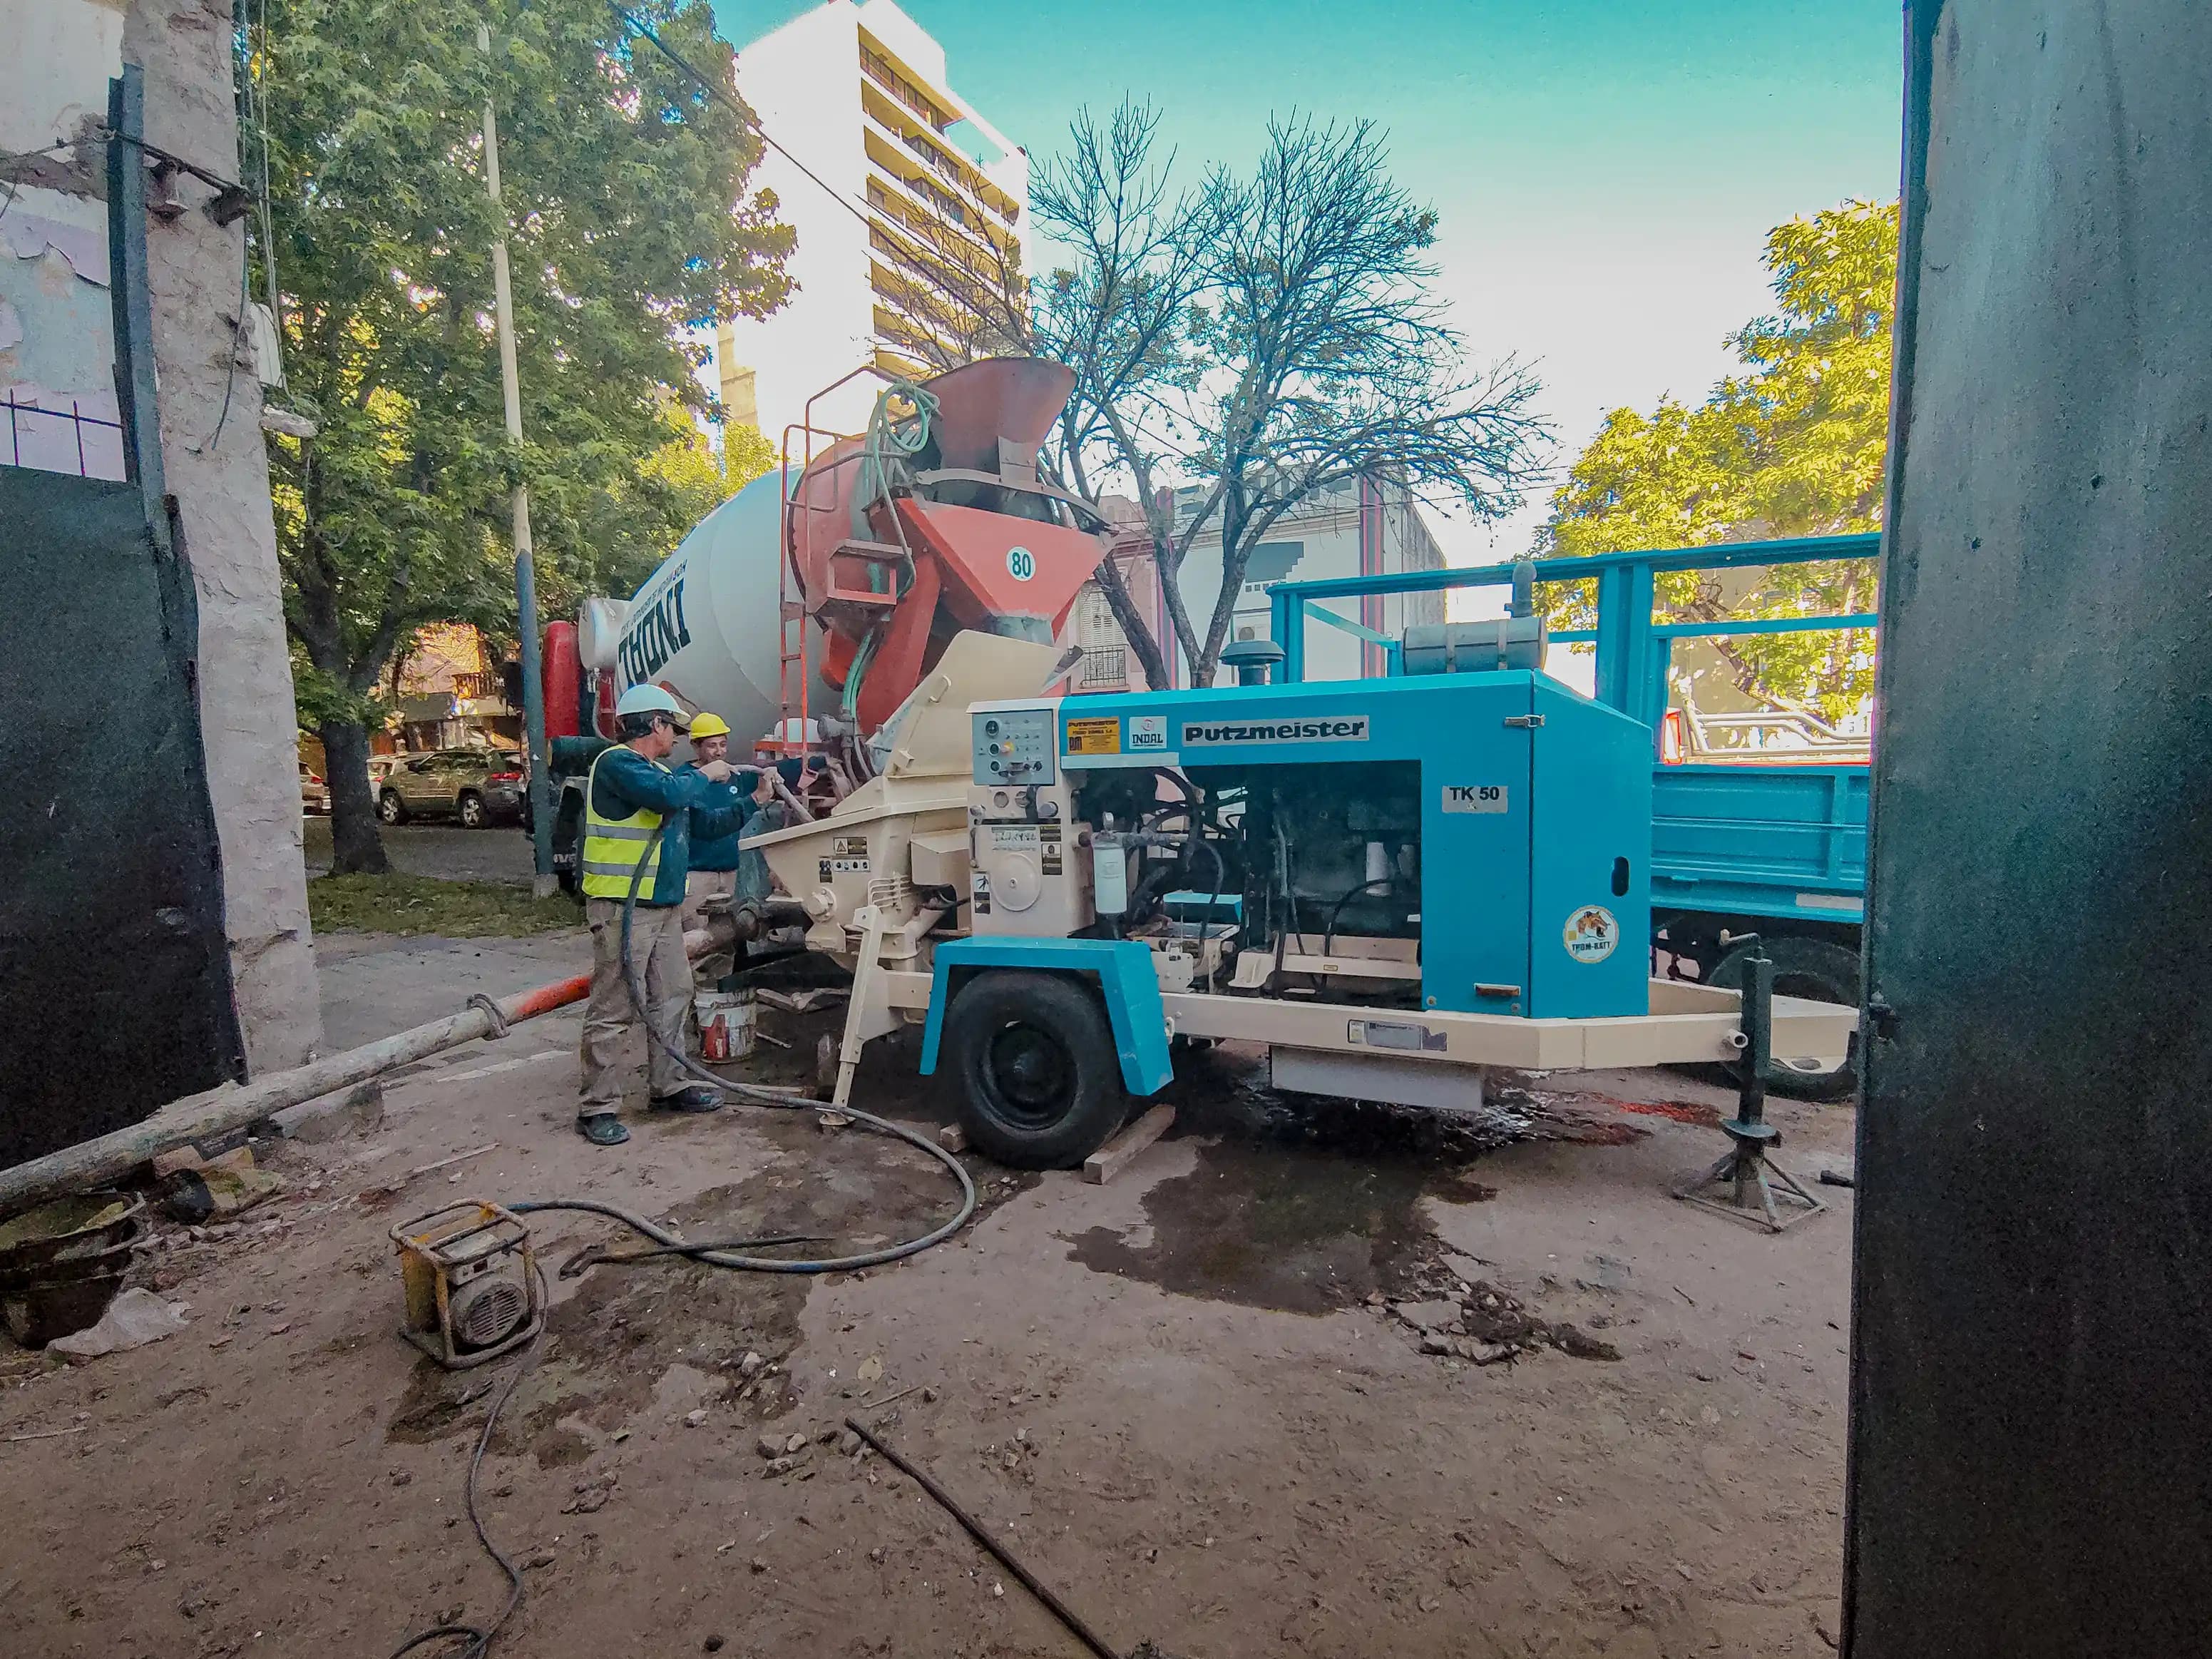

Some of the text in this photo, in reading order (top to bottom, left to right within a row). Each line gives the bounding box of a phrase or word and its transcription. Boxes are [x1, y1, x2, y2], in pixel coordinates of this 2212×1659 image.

[1012, 552, 1031, 577] 80
[1132, 734, 1164, 744] INDAL
[1185, 722, 1365, 742] Putzmeister
[1449, 787, 1500, 800] TK 50
